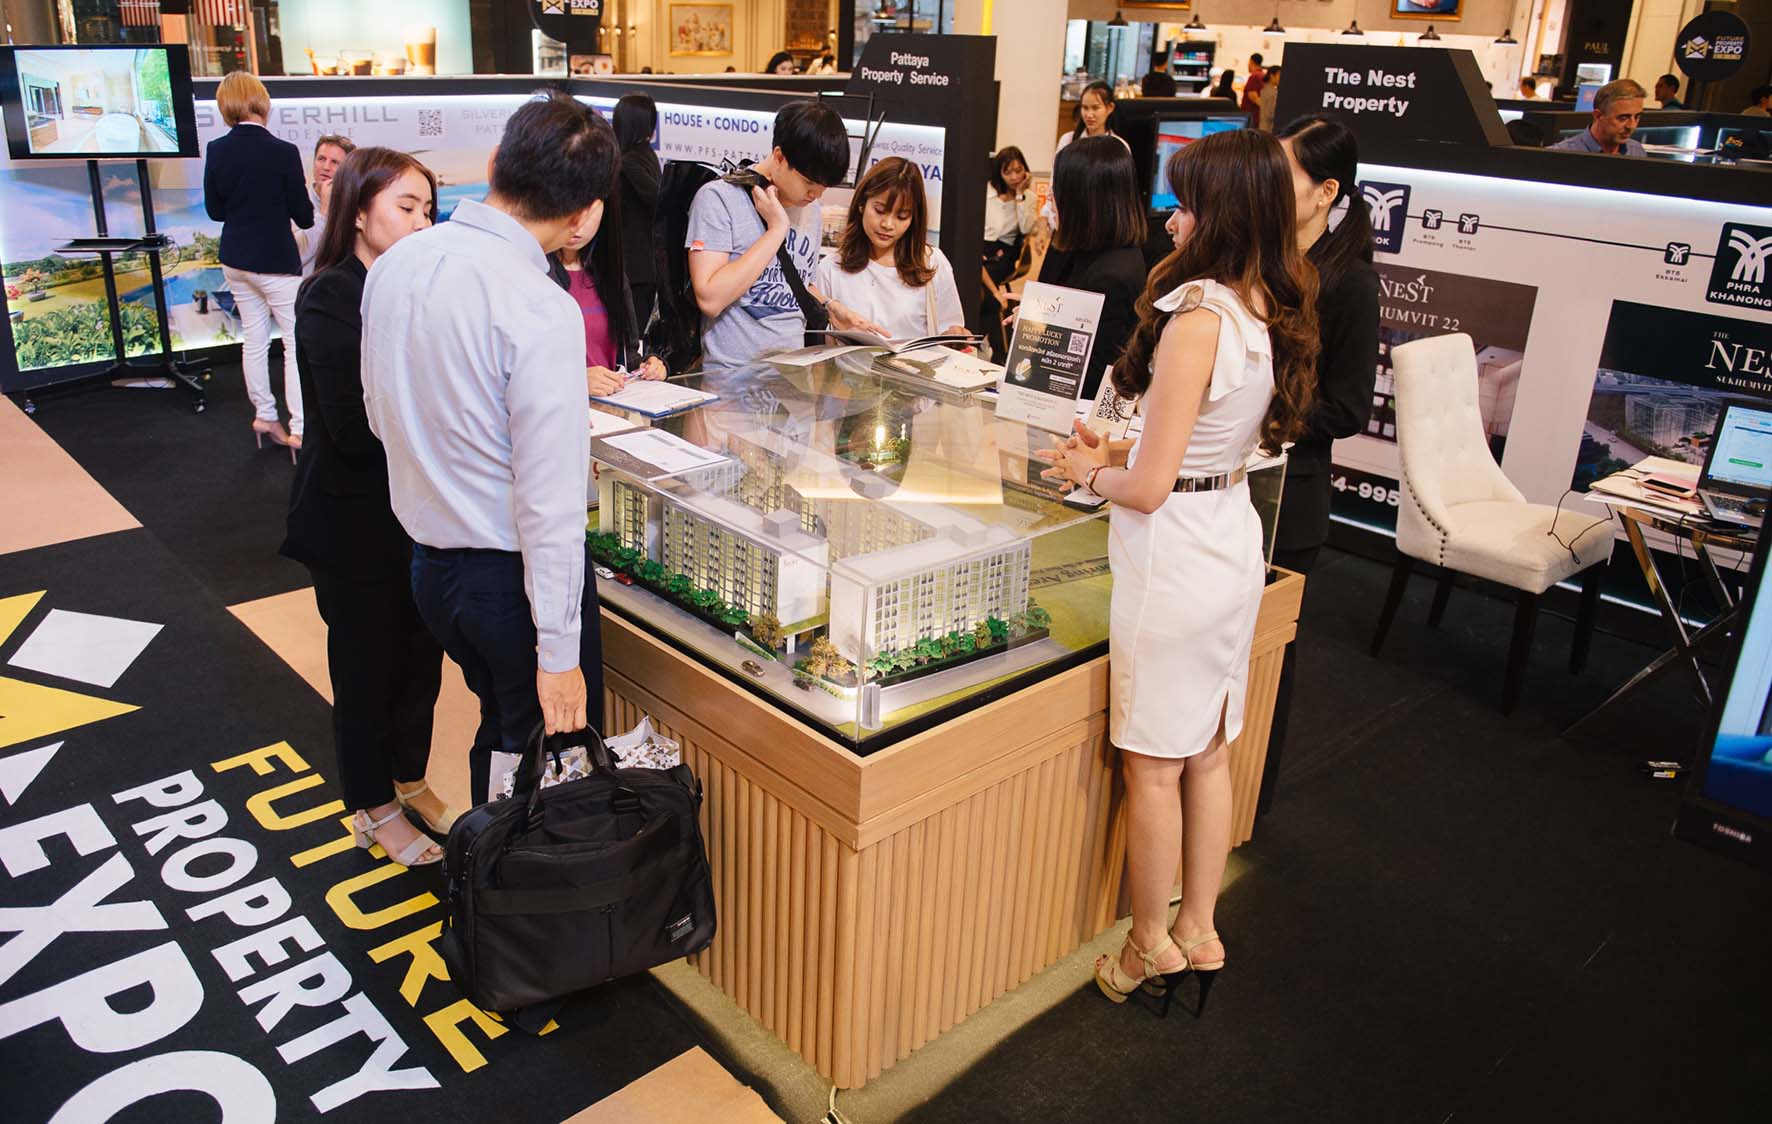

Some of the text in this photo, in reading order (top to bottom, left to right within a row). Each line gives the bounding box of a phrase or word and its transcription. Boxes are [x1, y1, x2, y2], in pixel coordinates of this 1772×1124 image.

[571, 0, 599, 9] EXPO
[1713, 46, 1743, 54] EXPO
[890, 52, 930, 69] Pattaya
[861, 67, 949, 86] Property Service
[1324, 67, 1416, 88] The Nest
[1322, 92, 1409, 117] Property
[664, 111, 759, 133] HOUSE CONDO
[891, 140, 916, 155] Quality
[918, 143, 943, 155] Service
[1378, 279, 1434, 304] NEST
[1726, 281, 1761, 294] PHRA
[1709, 290, 1772, 307] KHANONG
[1441, 317, 1461, 331] 22
[1022, 332, 1060, 347] PROMOTION
[1043, 328, 1063, 340] LUCKY
[1713, 331, 1730, 339] THE
[1331, 473, 1400, 507] 4-995
[111, 769, 442, 1114] PROPERTY
